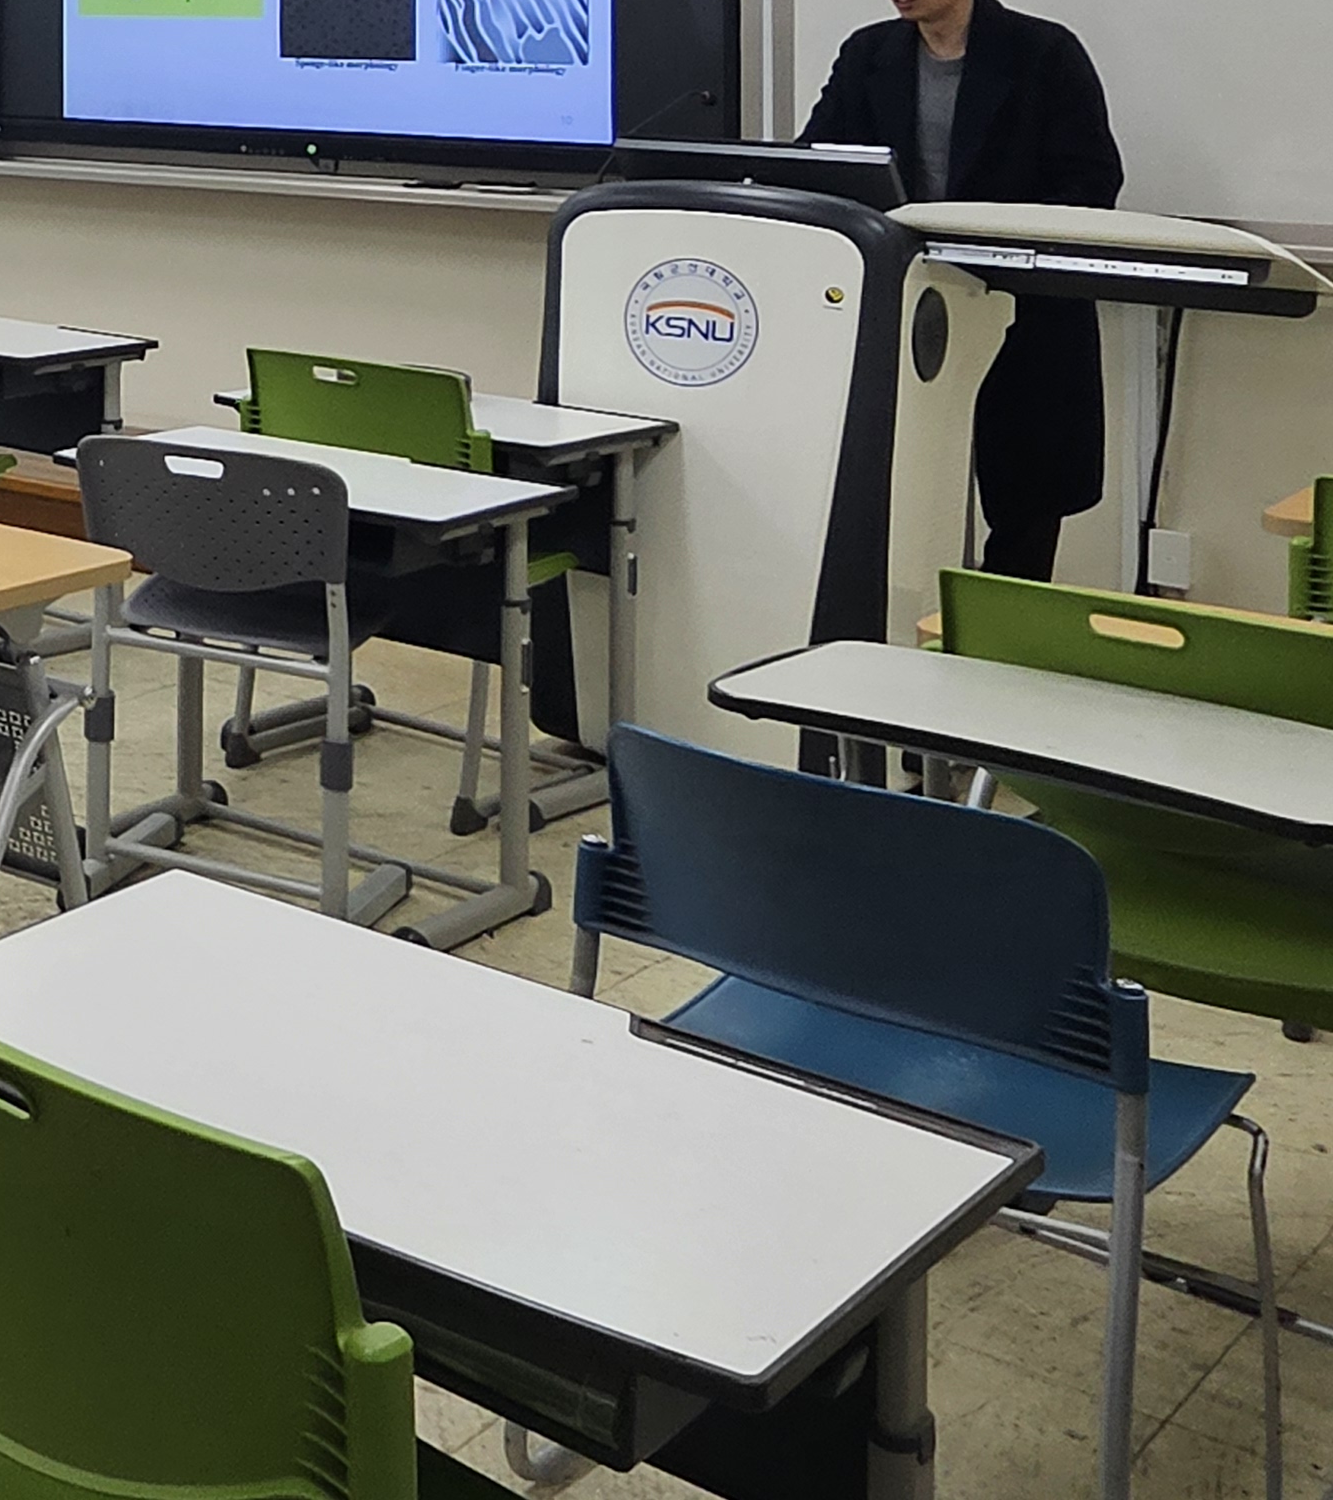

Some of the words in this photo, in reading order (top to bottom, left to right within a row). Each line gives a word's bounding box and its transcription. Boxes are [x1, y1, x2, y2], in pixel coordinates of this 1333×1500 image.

[644, 313, 735, 343] KSNU
[648, 358, 706, 382] NATIONAL
[709, 323, 754, 379] UNIVERSITY
